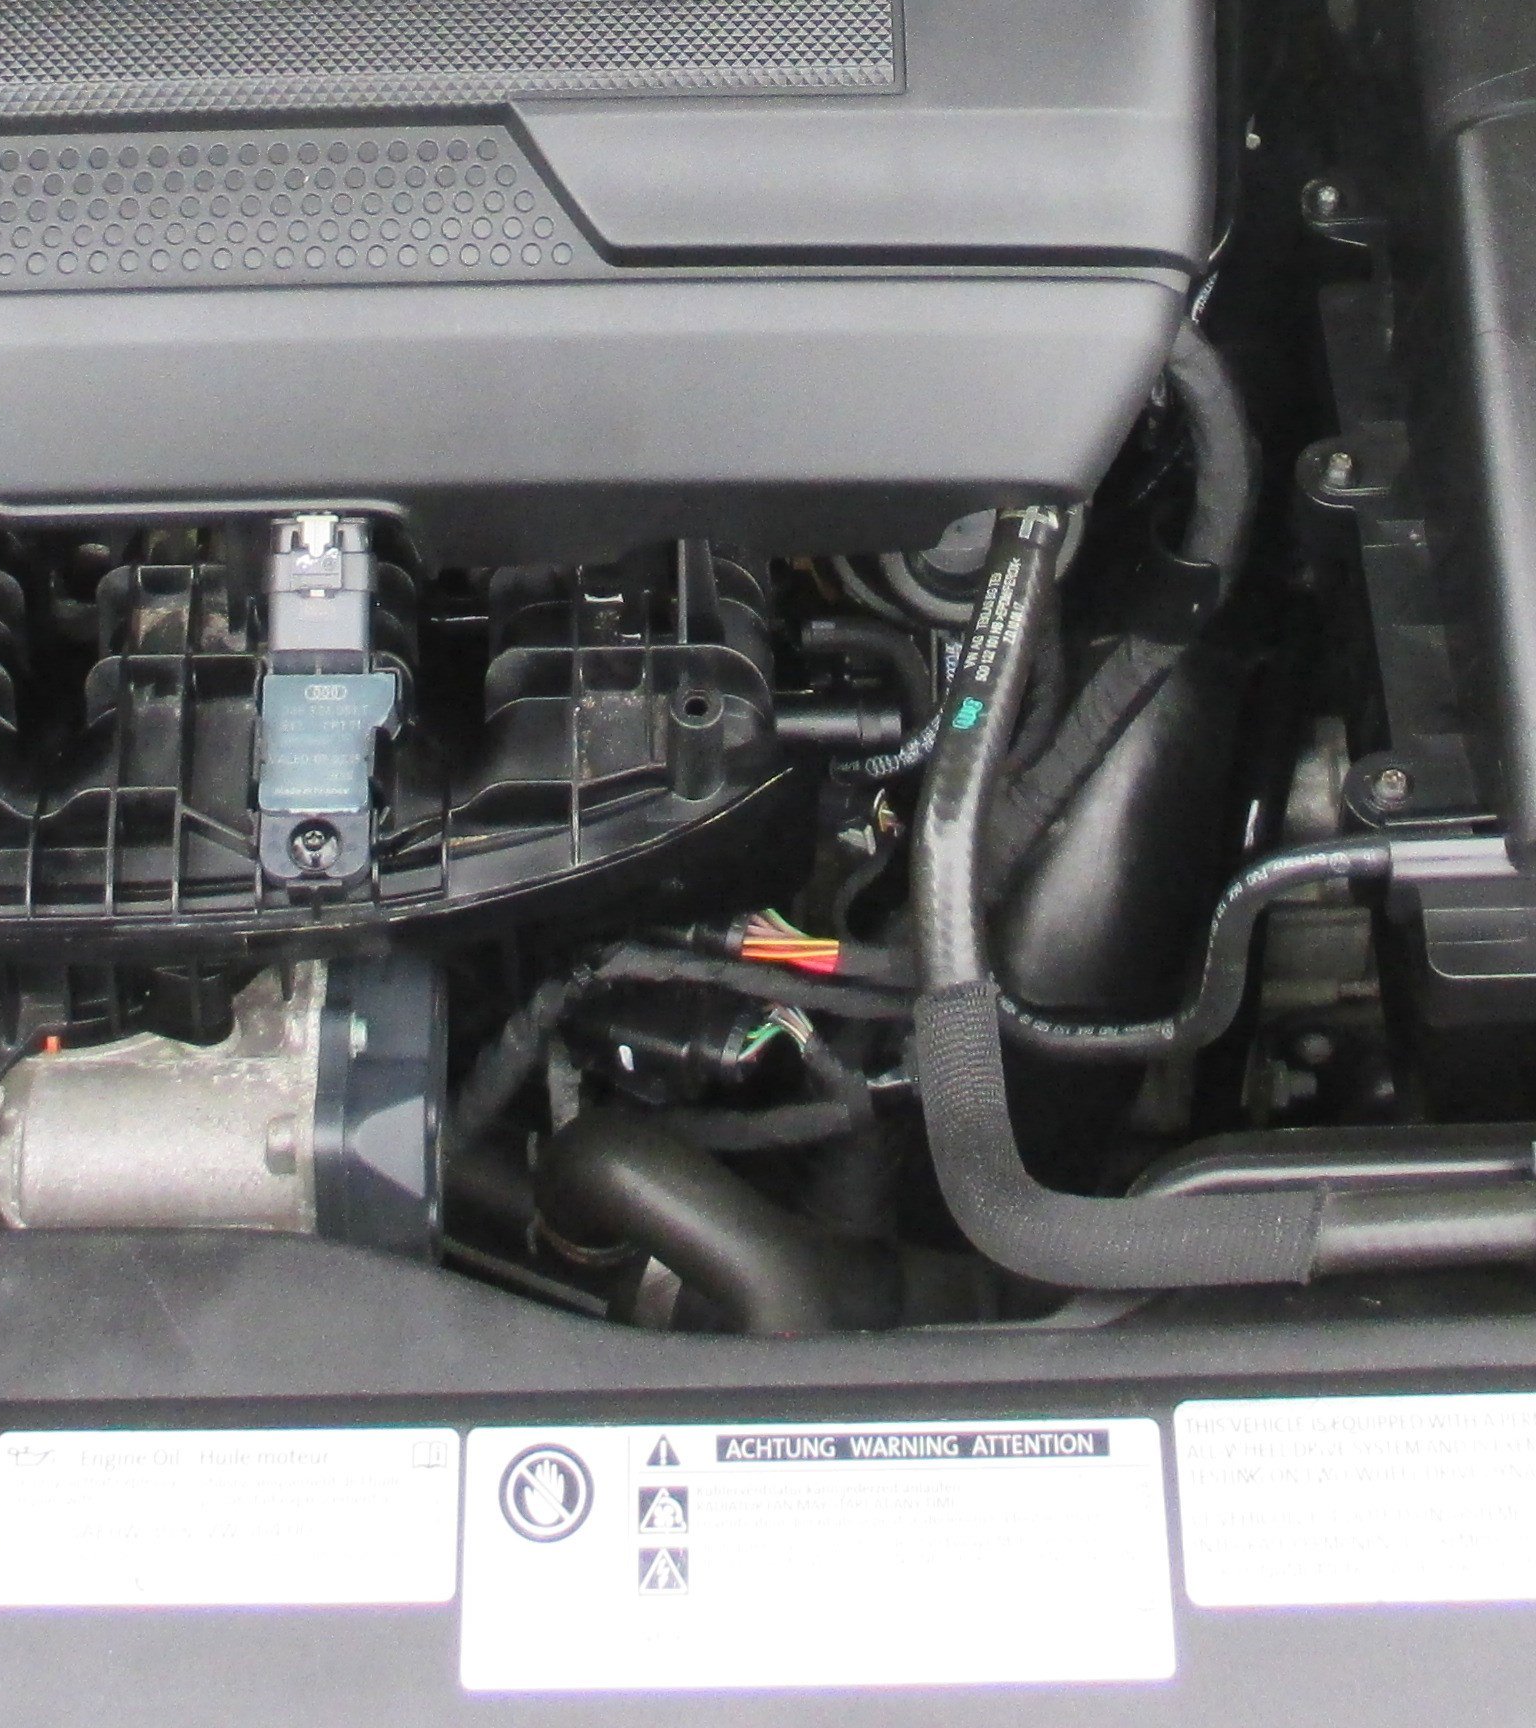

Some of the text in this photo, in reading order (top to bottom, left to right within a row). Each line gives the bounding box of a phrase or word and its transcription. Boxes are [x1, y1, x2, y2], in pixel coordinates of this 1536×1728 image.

[1184, 1416, 1224, 1435] THIS
[1228, 1415, 1303, 1434] VEHICLE
[1310, 1415, 1326, 1432] IS
[1329, 1414, 1422, 1433] EQUIPPED
[1428, 1412, 1476, 1430] WITH
[199, 1446, 329, 1466] Huile moteur
[726, 1433, 1094, 1458] ACHTUNG WARNING ATTENTION
[80, 1447, 180, 1472] Engine Oil
